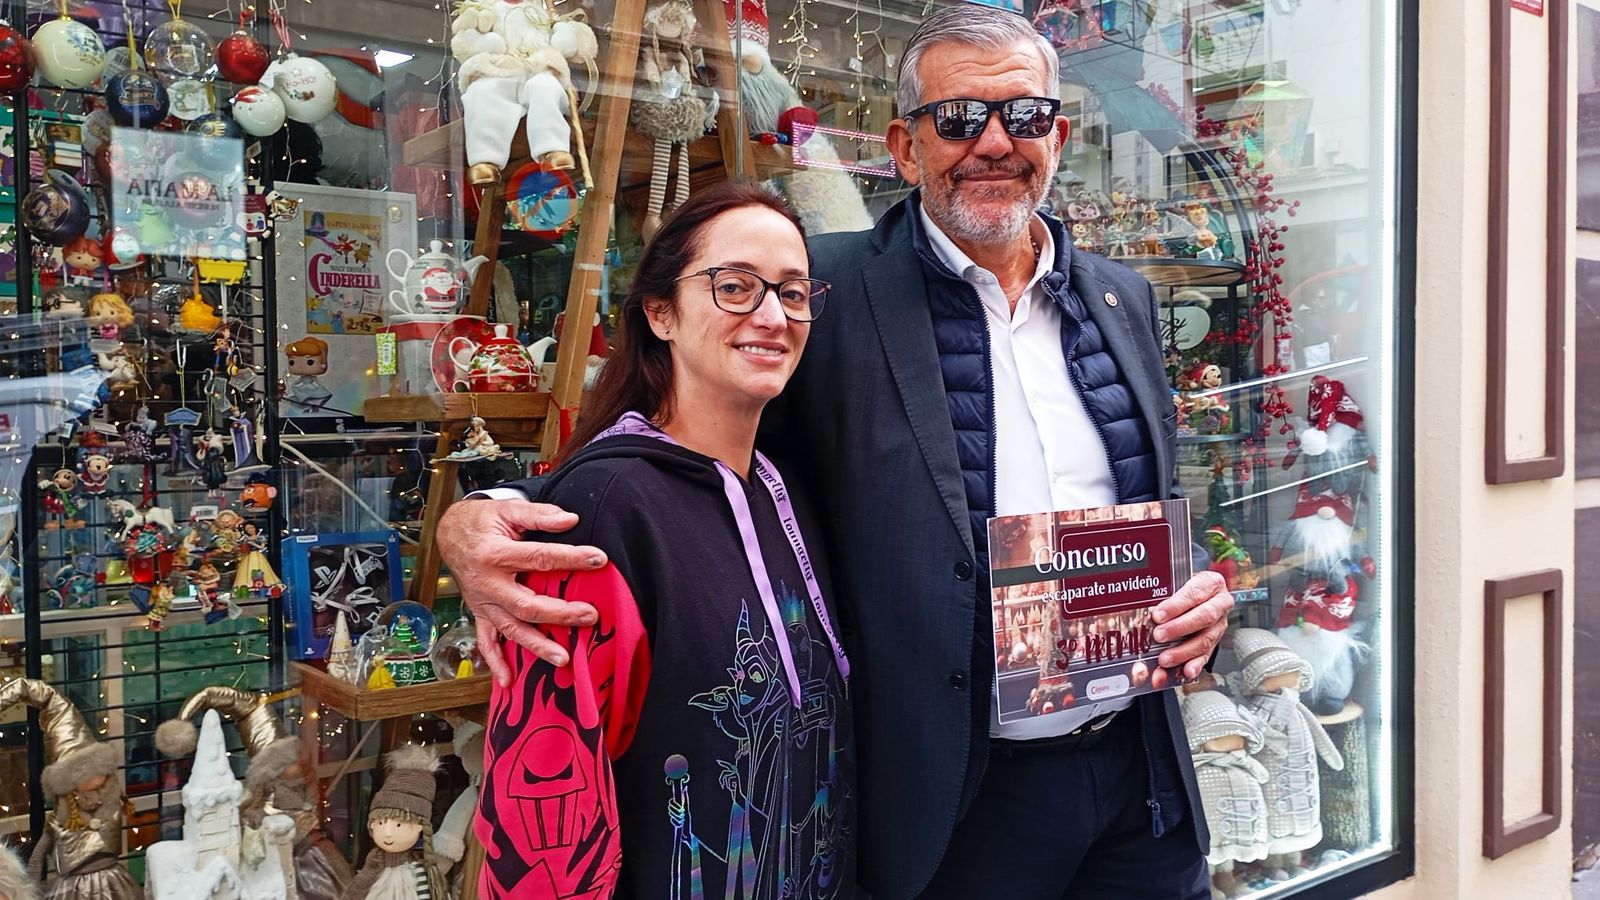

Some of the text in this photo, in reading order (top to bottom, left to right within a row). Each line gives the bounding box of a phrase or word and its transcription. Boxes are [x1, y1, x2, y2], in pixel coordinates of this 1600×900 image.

[308, 252, 382, 297] CINDERELLA
[1034, 541, 1146, 574] Concurso
[1041, 574, 1160, 604] escaparate navideño
[1151, 587, 1168, 598] 2025
[1085, 624, 1151, 665] PREMIO
